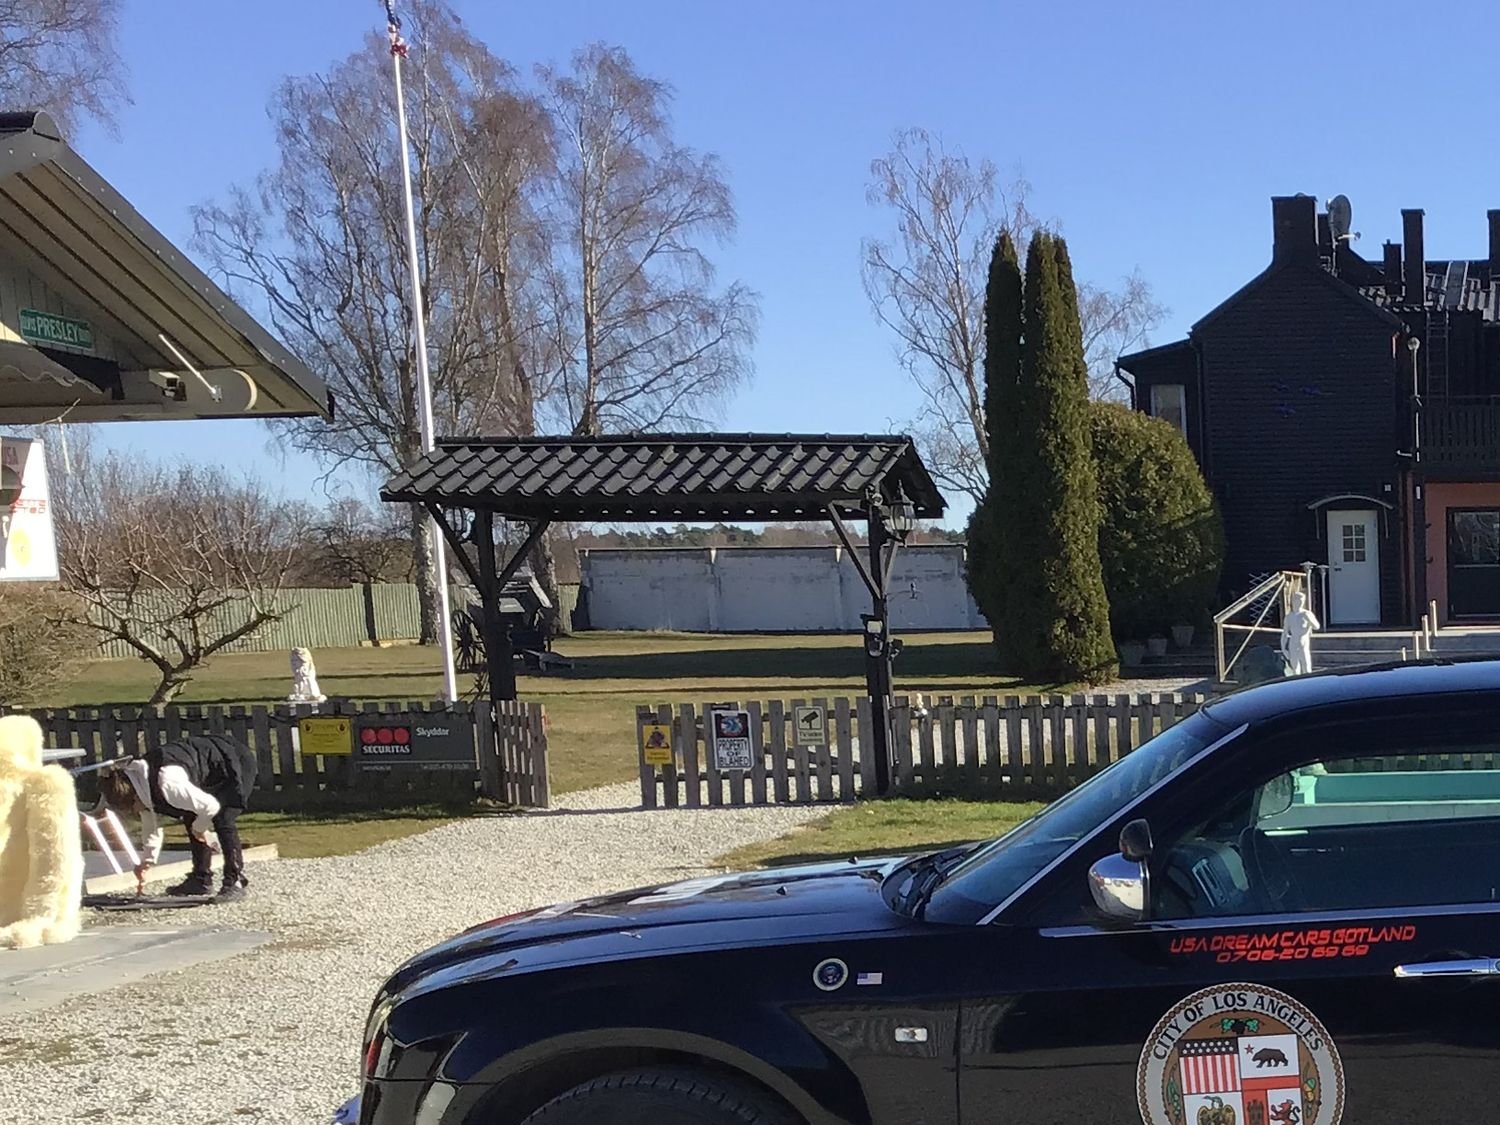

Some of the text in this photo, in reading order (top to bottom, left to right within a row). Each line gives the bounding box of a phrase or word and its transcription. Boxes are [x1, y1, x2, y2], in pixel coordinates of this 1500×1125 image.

[36, 316, 79, 342] PRESLEY
[415, 727, 450, 737] Skyddar
[362, 745, 410, 754] SECURITAS
[1170, 925, 1416, 953] USA DREAM CARS GOTLAND
[1153, 992, 1324, 1061] CITY OF LOS ANGELES
